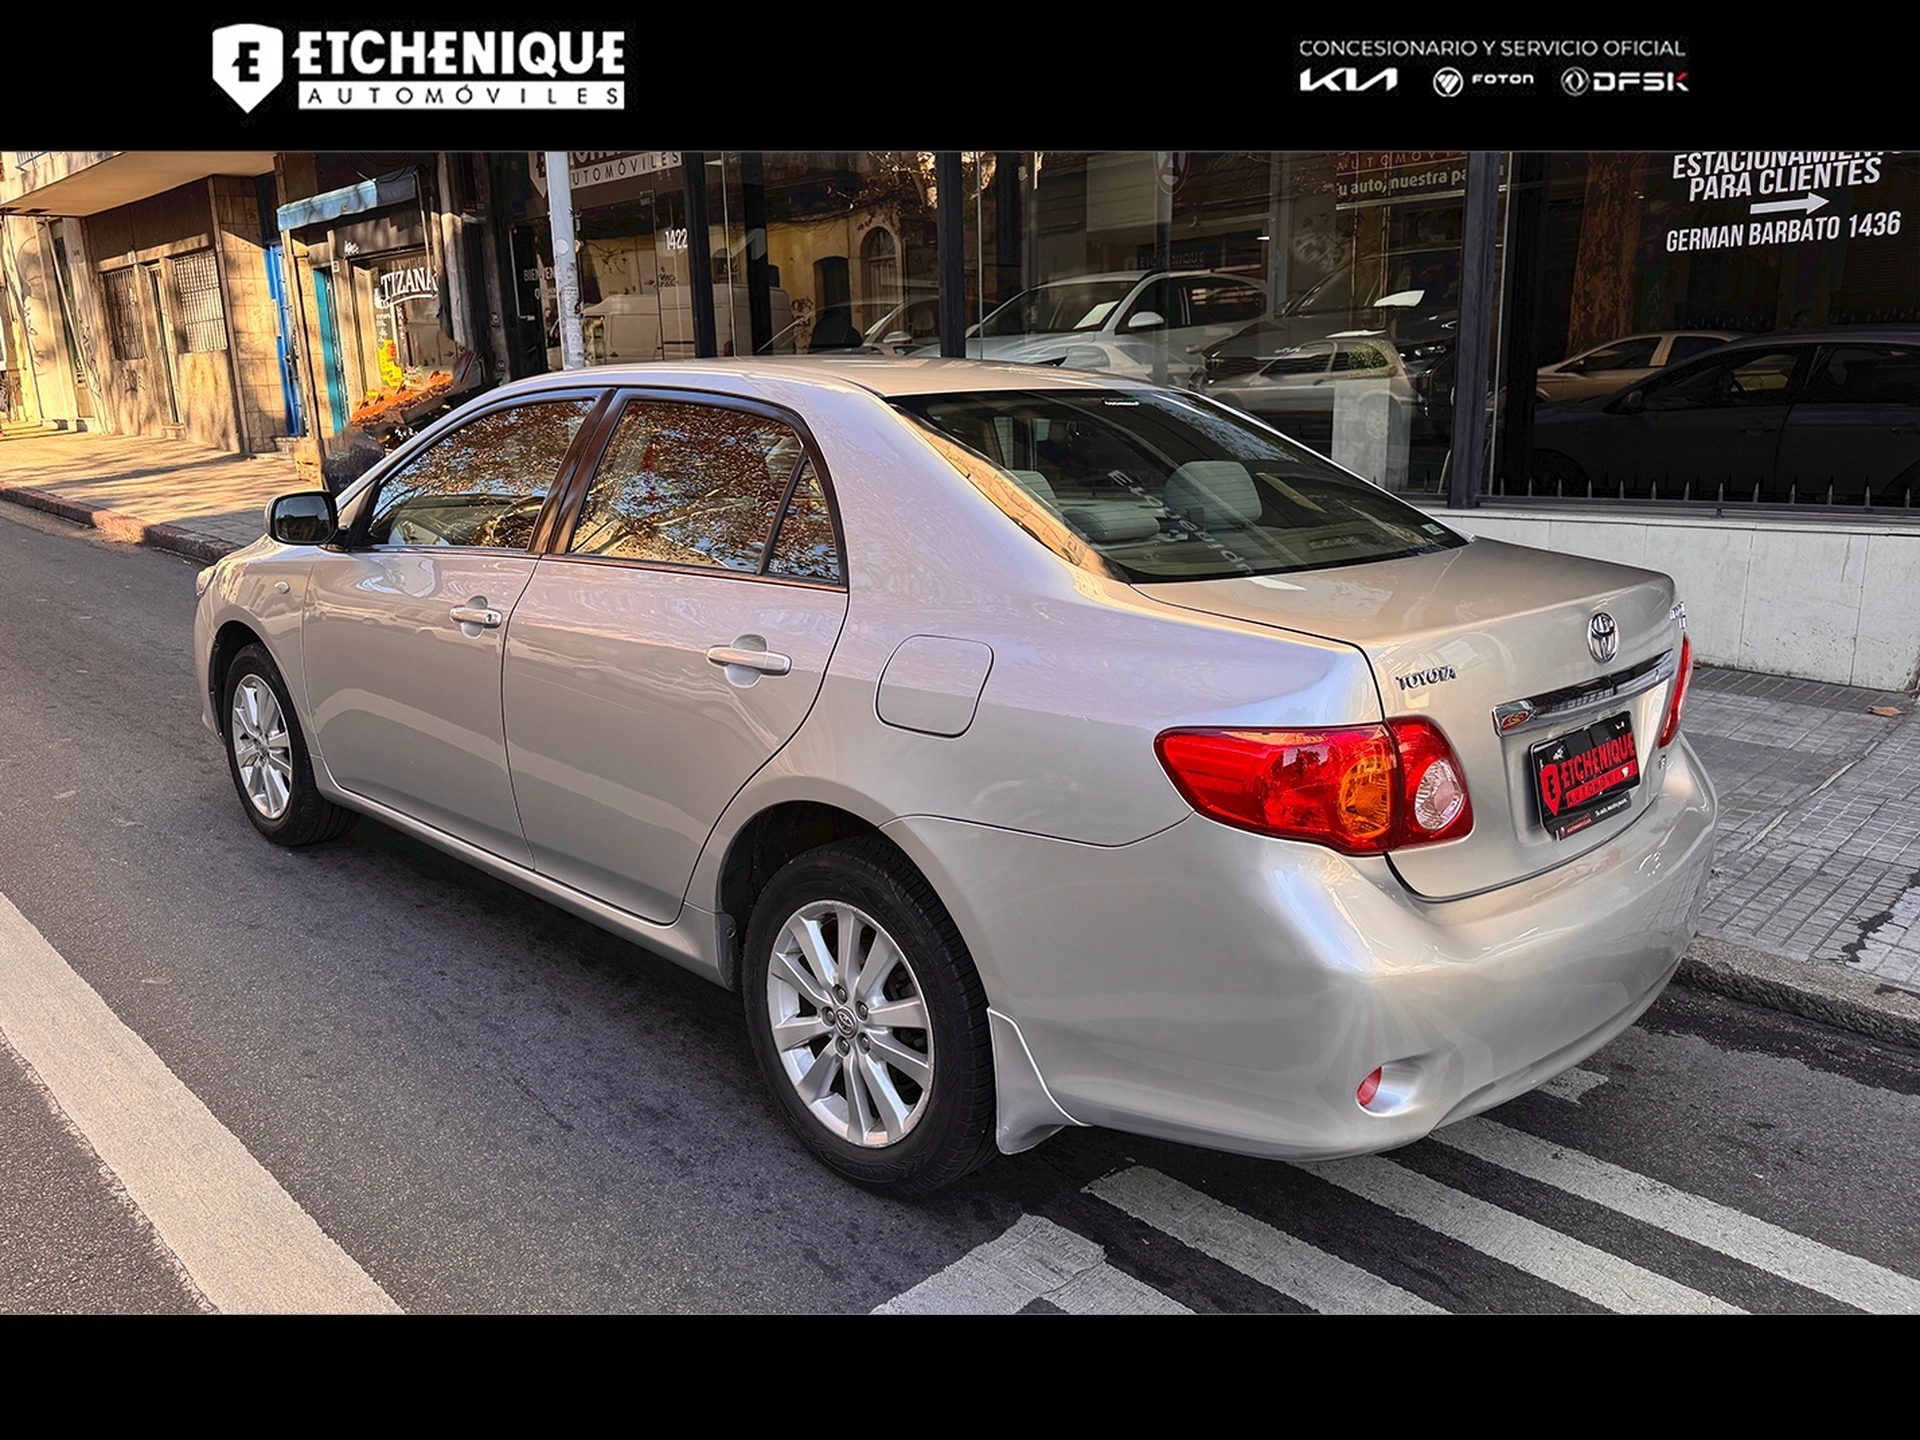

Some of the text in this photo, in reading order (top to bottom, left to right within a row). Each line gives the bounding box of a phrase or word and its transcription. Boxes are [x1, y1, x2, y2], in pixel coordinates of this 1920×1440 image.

[571, 151, 680, 186] UTOMÓVILES
[1350, 178, 1387, 195] auto,
[1390, 170, 1448, 189] nuestra
[1689, 157, 1882, 202] PARA CLIENTES
[665, 228, 688, 250] 1422
[1666, 210, 1902, 252] GERMAN BARBATO 1436
[380, 267, 439, 300] TIZANA
[1395, 665, 1457, 691] TOYOTA
[1561, 732, 1636, 789] ETCHENIQUE
